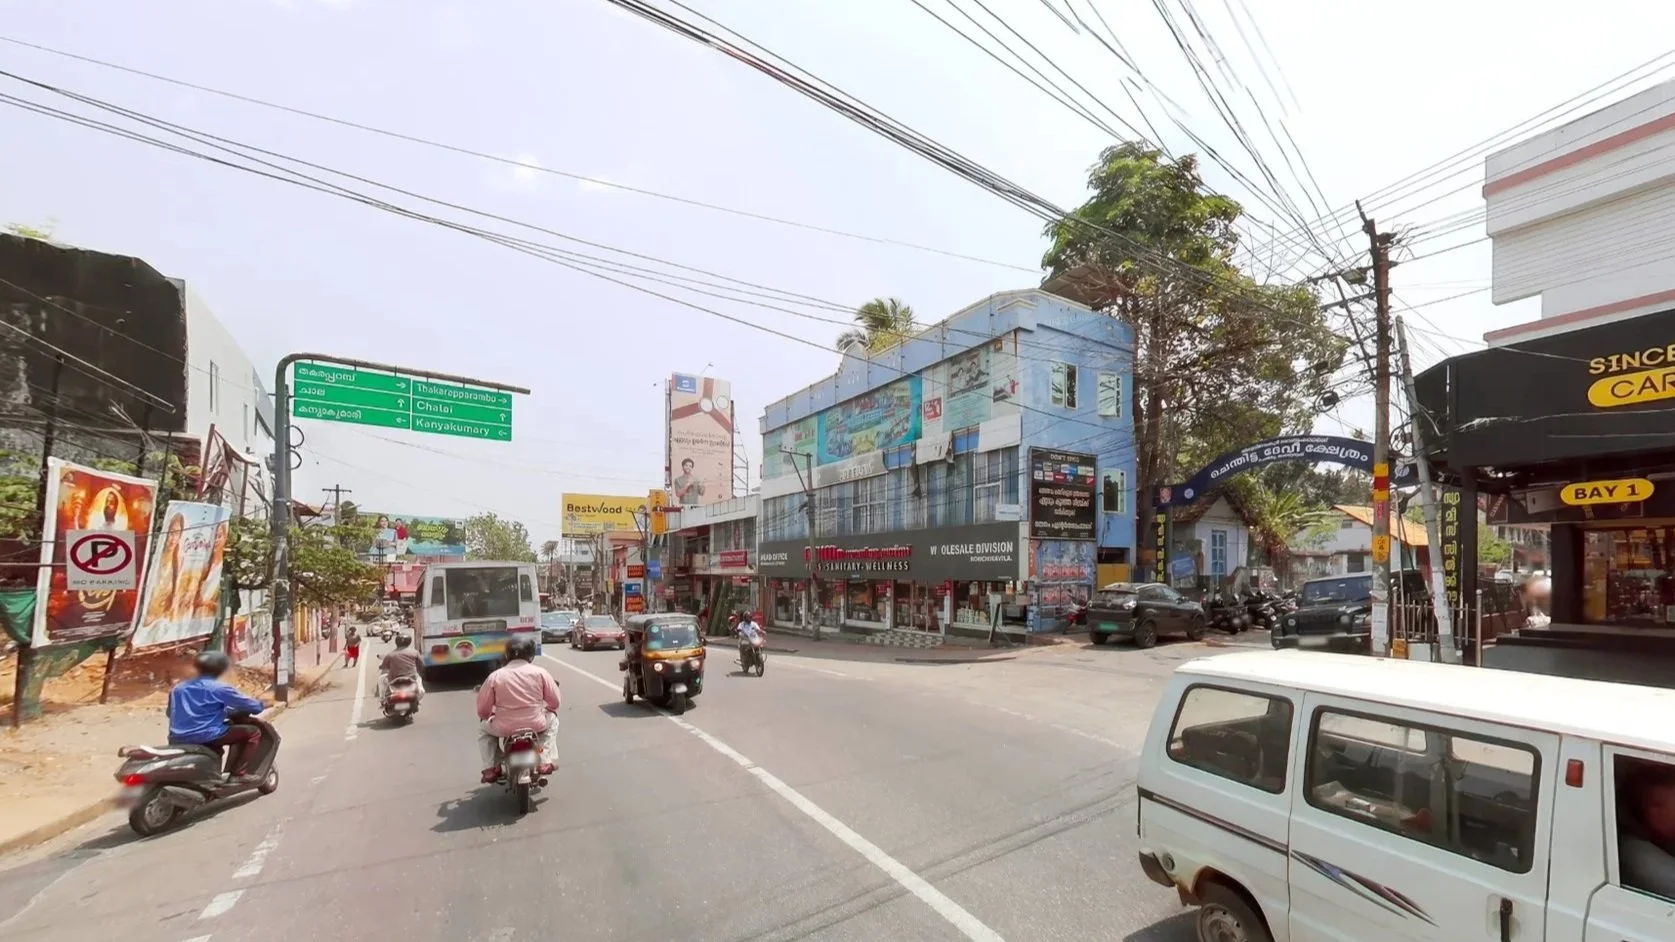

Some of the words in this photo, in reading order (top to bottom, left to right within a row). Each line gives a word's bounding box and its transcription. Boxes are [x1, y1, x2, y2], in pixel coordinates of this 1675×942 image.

[298, 387, 326, 397] ചാല
[298, 405, 362, 420] കന്യാകുമാരി
[416, 400, 453, 414] Chalai
[416, 418, 490, 437] Kanyakumary
[1305, 444, 1369, 462] ക്ഷേത്രം
[1574, 485, 1618, 500] BAY
[1627, 483, 1639, 497] 1
[975, 541, 1013, 554] DIVISION
[865, 560, 909, 571] WELLNESS
